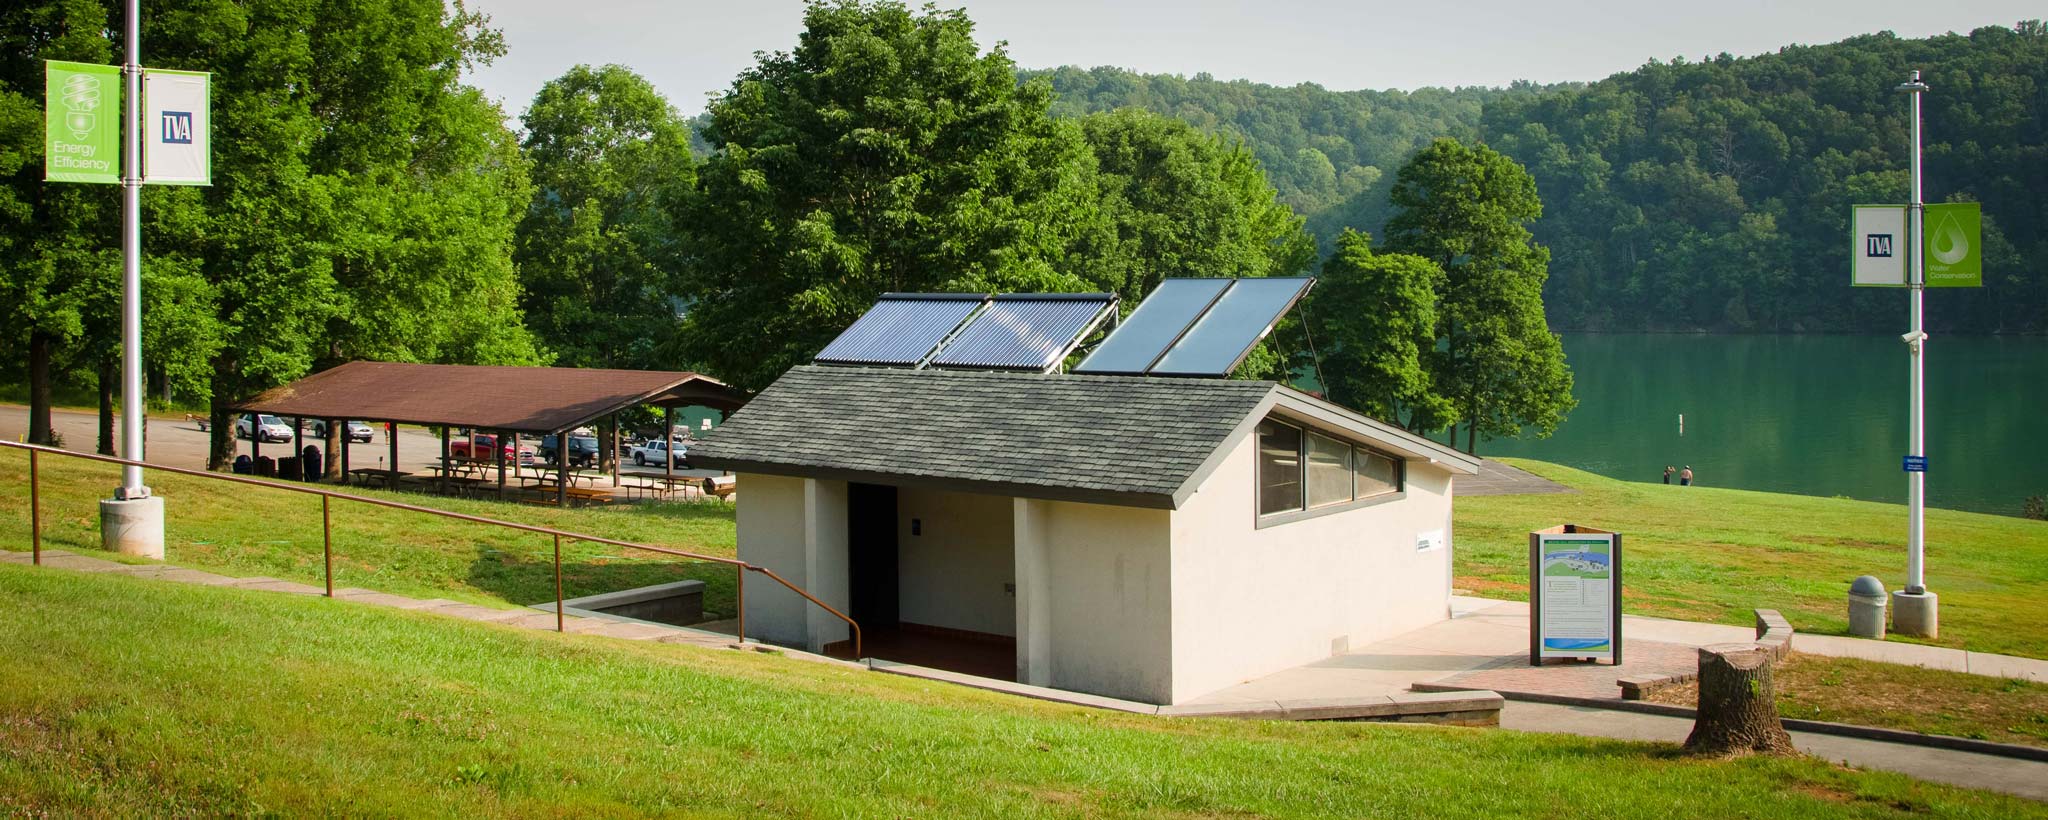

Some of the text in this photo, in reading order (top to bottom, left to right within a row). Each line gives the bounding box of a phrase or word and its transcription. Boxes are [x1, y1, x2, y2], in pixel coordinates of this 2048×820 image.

[163, 115, 191, 140] TVA
[54, 140, 96, 157] Energy
[54, 155, 110, 172] Efficiency
[1868, 237, 1891, 254] TVA
[1929, 272, 1976, 280] Conservation
